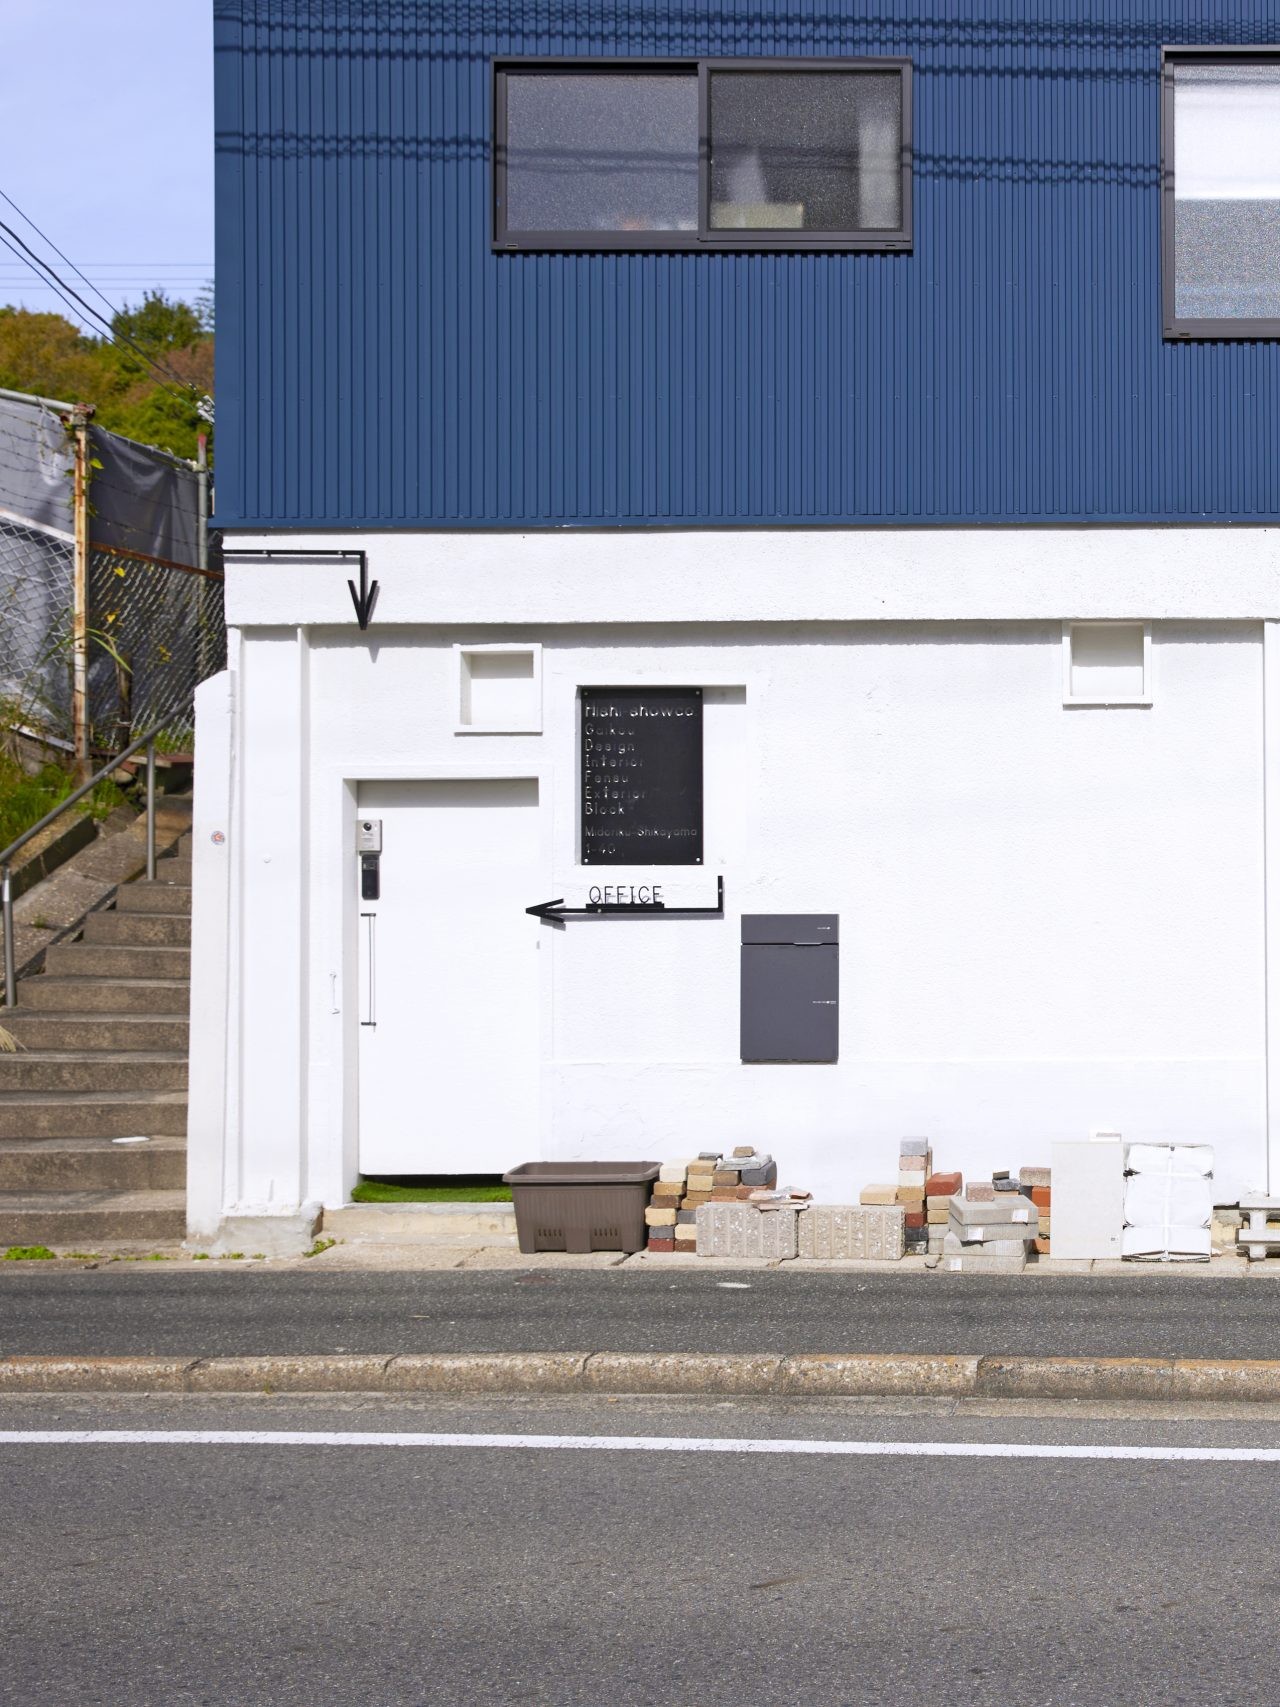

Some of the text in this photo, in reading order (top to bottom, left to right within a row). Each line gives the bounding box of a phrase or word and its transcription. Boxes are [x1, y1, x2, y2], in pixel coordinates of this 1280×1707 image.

[585, 739, 635, 754] Design
[585, 754, 644, 767] Interior
[585, 785, 646, 799] Exterior
[585, 802, 625, 815] Block
[589, 886, 663, 904] OFFICE
